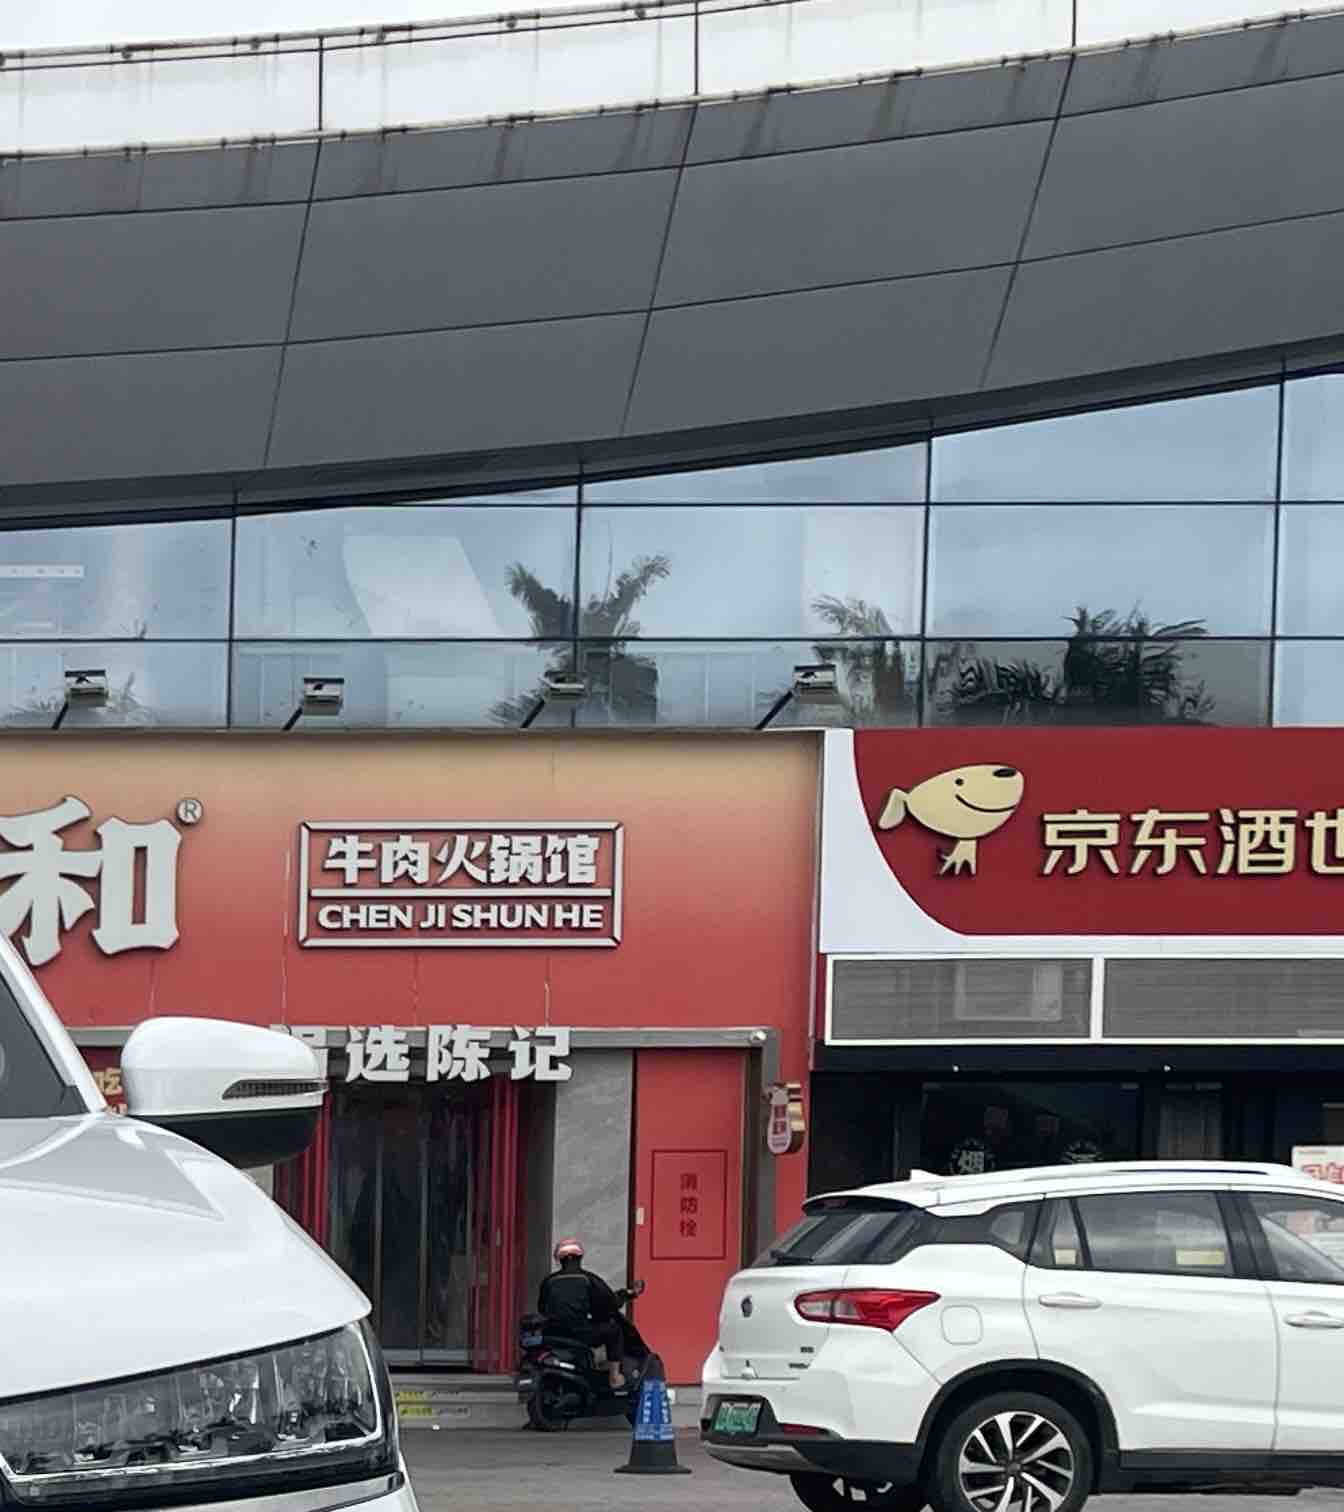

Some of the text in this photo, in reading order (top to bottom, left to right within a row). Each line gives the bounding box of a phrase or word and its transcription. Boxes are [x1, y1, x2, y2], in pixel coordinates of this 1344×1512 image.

[322, 833, 599, 886] 牛肉火锅馆
[317, 903, 605, 930] CHEN JI SHUN HE
[679, 1172, 698, 1238] 消防栓
